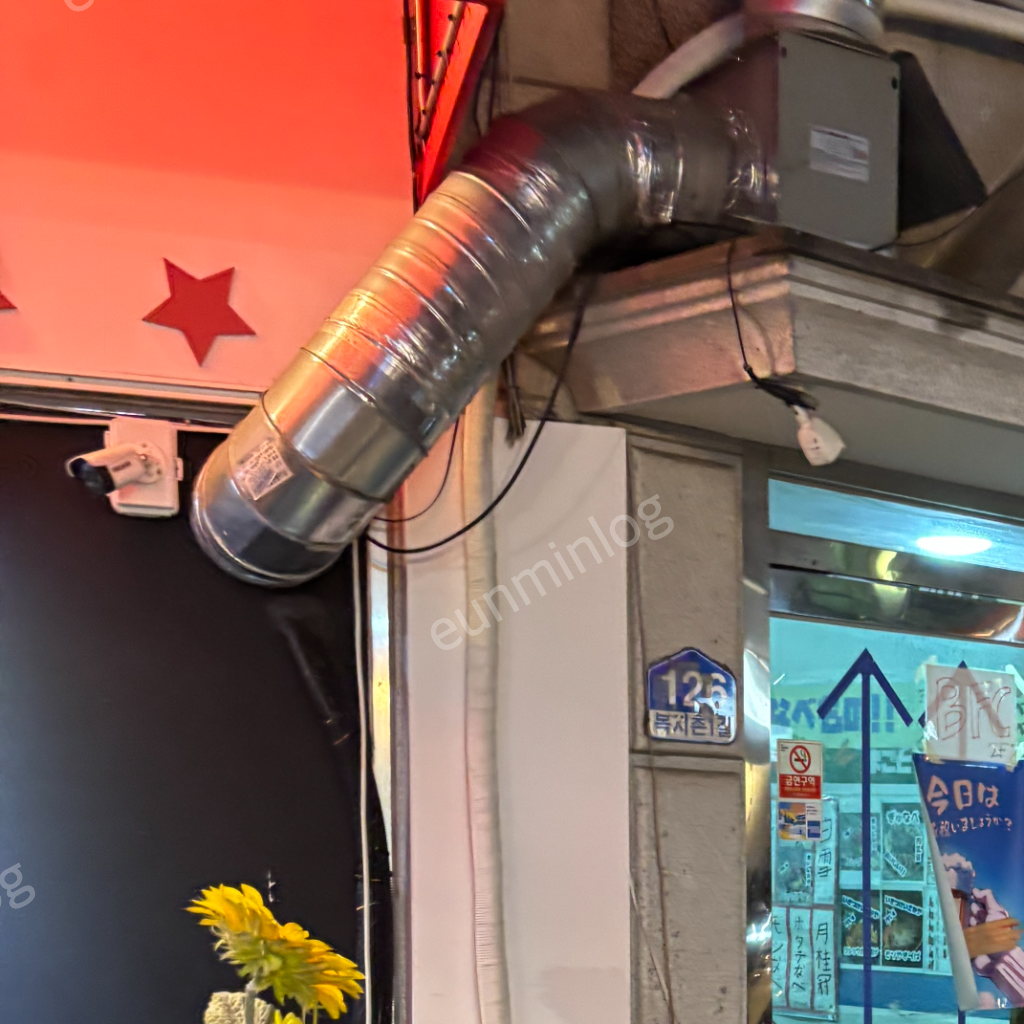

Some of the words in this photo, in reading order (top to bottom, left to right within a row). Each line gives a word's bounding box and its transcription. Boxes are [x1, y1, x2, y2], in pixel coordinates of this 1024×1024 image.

[660, 669, 728, 709] 126
[786, 775, 816, 787] 금연구역
[926, 774, 999, 816] 今日は
